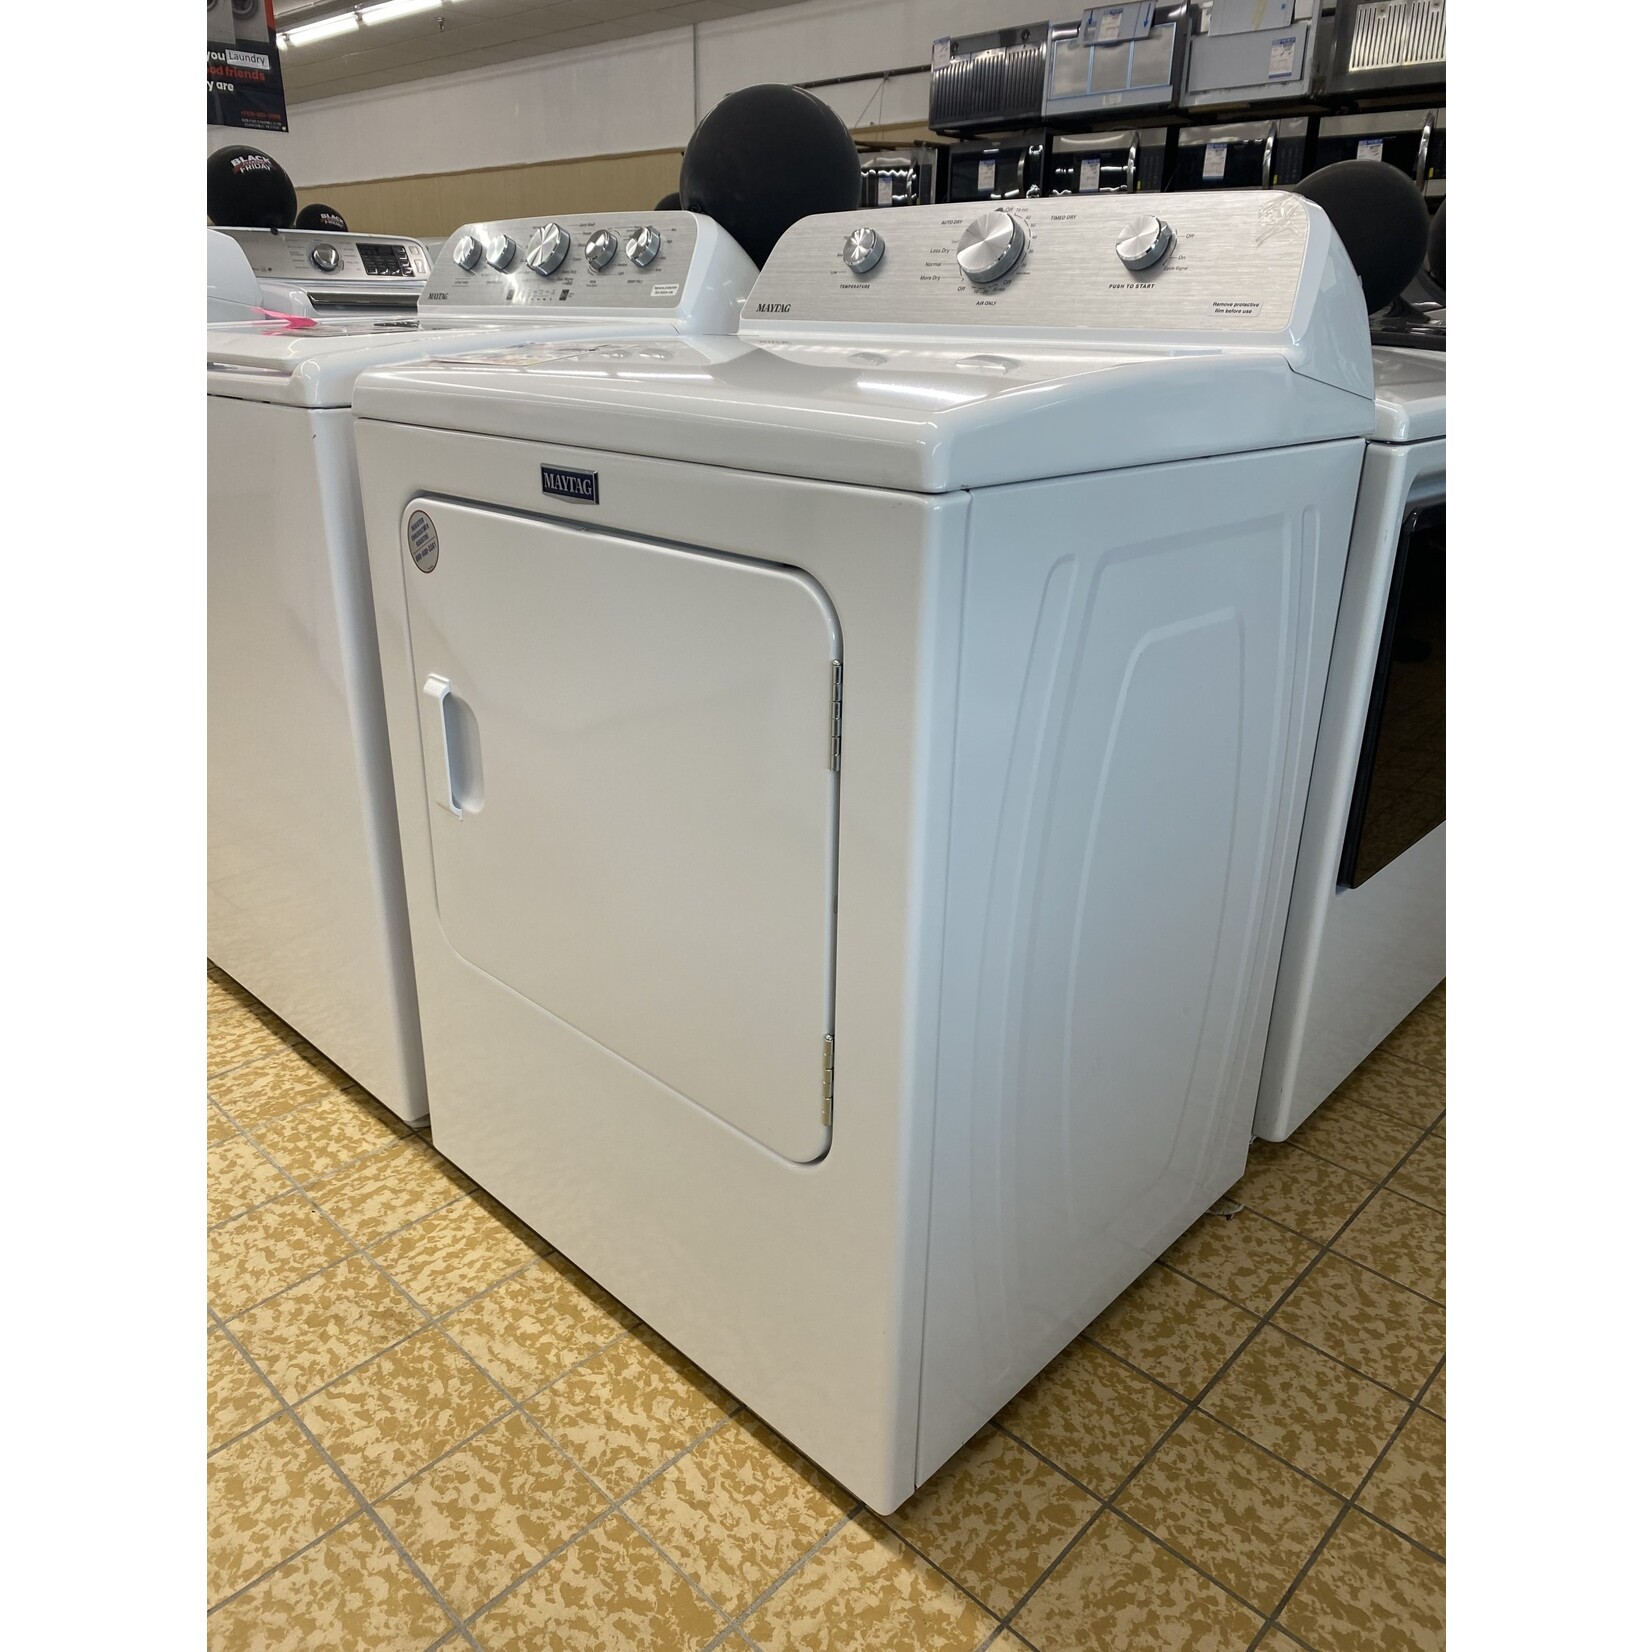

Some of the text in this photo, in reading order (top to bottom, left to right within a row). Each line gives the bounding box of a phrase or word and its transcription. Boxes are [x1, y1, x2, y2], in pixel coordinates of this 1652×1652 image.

[229, 51, 265, 65] Laundry
[225, 67, 265, 81] friends
[216, 82, 235, 91] are
[231, 155, 271, 167] BLACK
[240, 163, 271, 174] FRIDAY
[320, 213, 343, 224] BLACK
[756, 304, 791, 313] MAYTAG
[543, 472, 592, 496] MAYTAG
